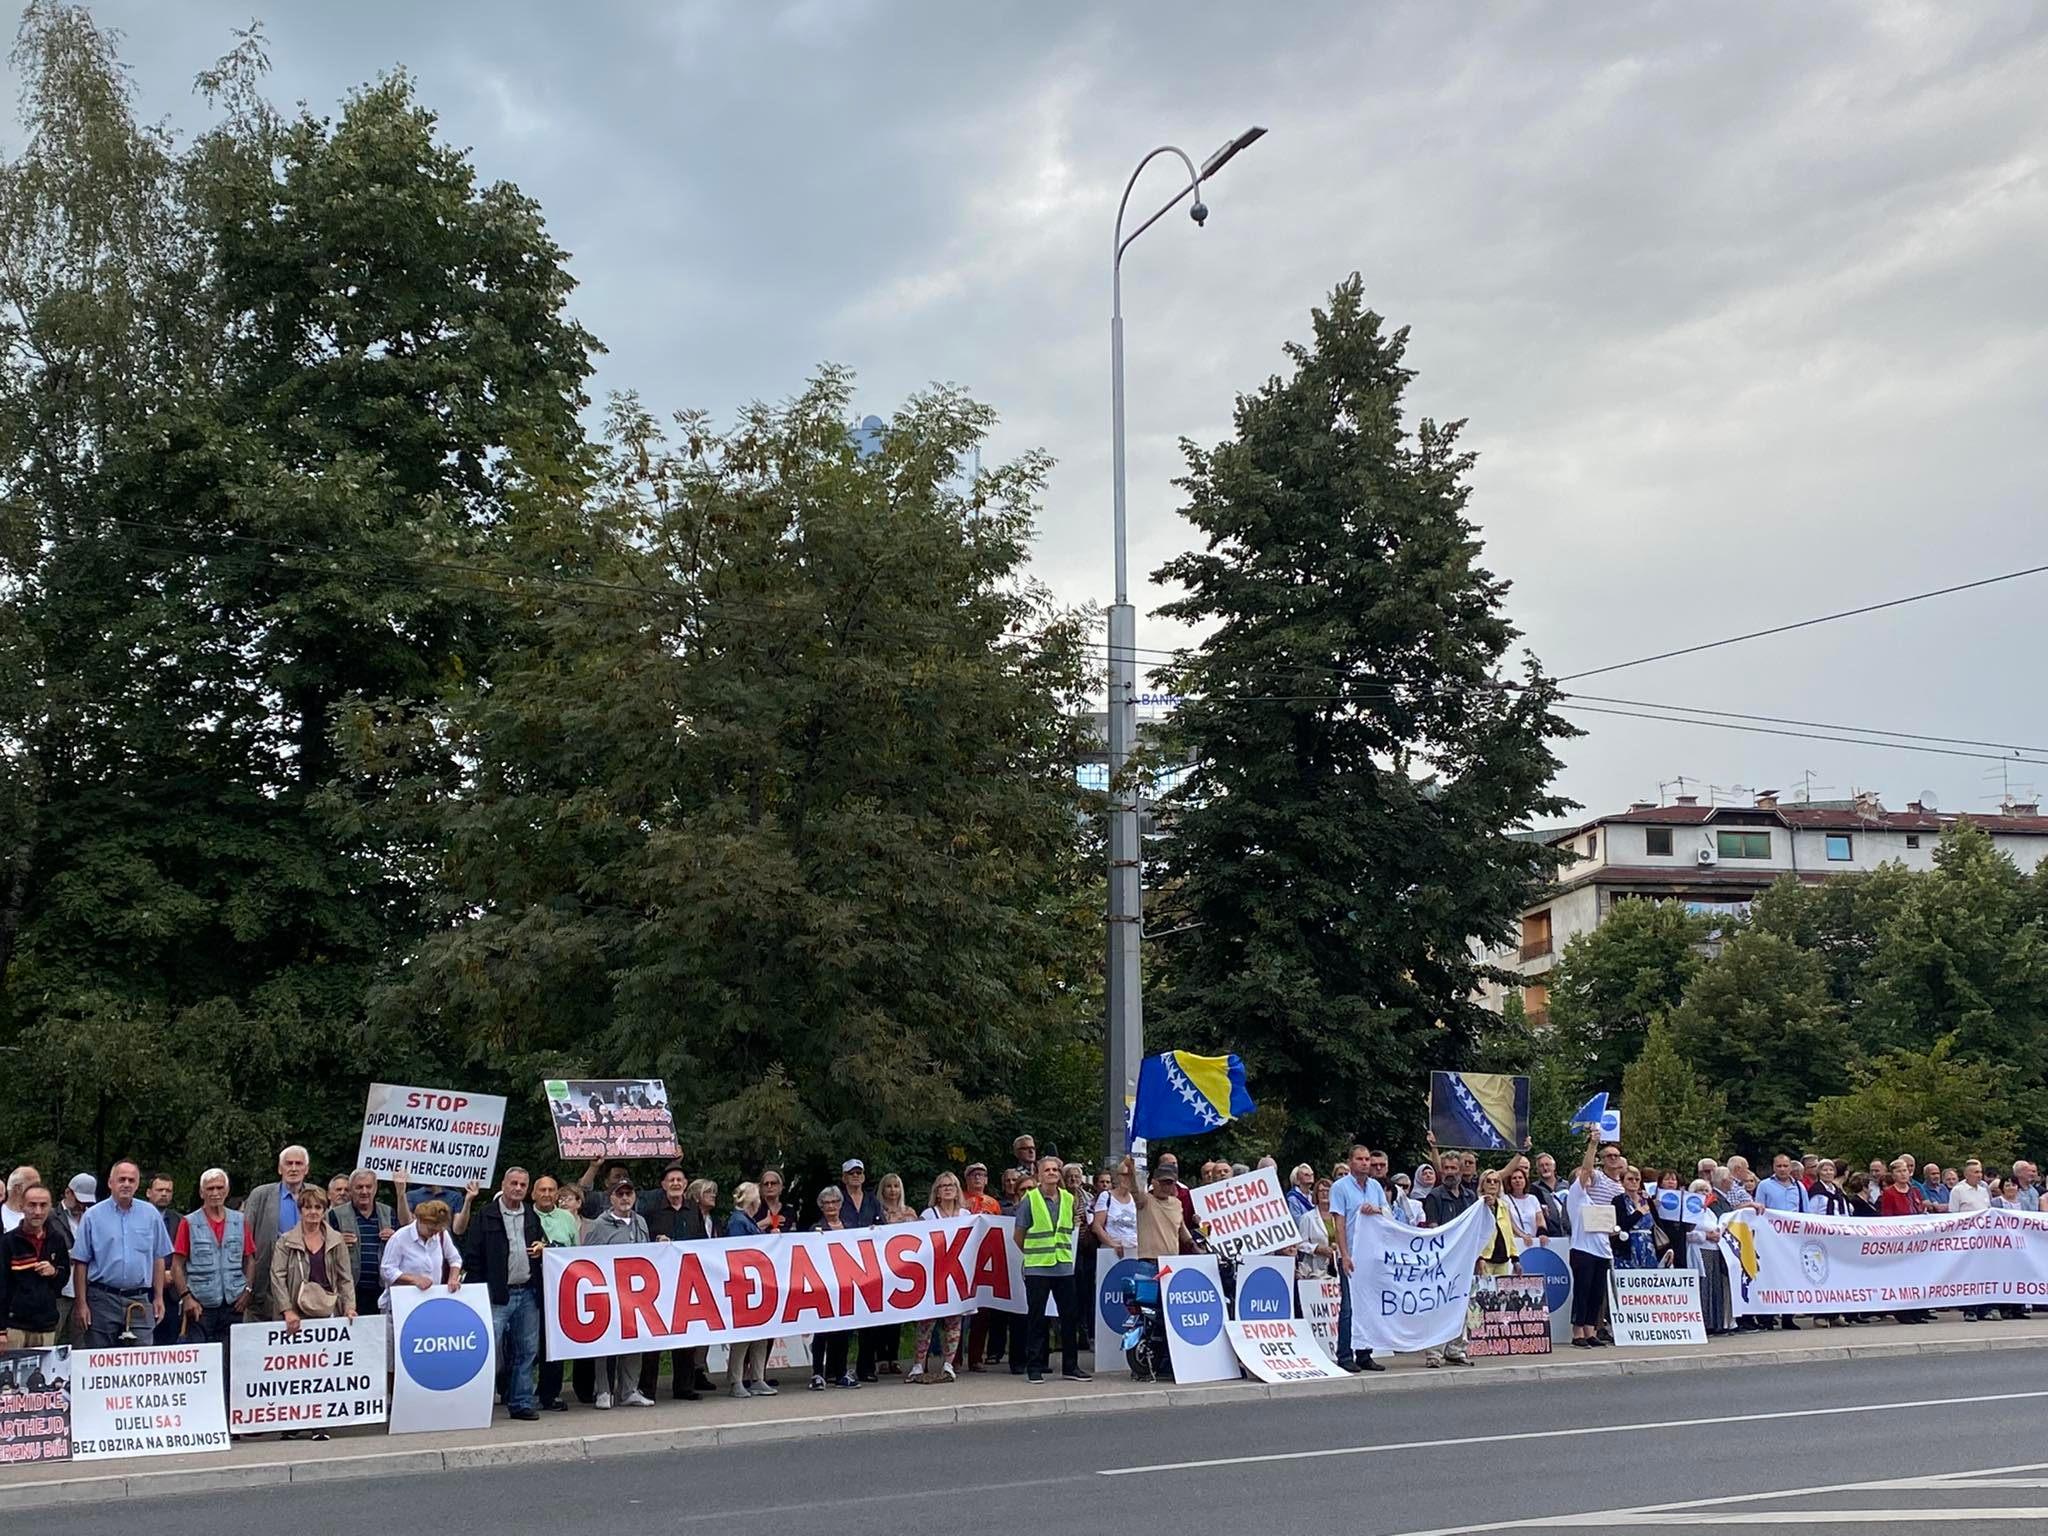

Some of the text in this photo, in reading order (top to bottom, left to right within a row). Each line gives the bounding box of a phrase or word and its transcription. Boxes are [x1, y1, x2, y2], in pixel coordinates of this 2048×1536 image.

[406, 1092, 468, 1112] STOP
[366, 1113, 501, 1137] DIPLOMATSKOJ AGRESIJI
[369, 1135, 490, 1158] HRVATSKE NA USTROJ
[364, 1156, 402, 1173] BOSNE
[410, 1160, 488, 1180] HERCEGOVINE
[1204, 1178, 1269, 1213] NEĆEMO
[1200, 1198, 1288, 1236] PRIHVATITI
[1804, 1221, 1851, 1236] MINUTE
[1852, 1224, 1868, 1236] TO
[1933, 1221, 1955, 1234] FOR
[1955, 1216, 1992, 1231] PEACE
[1994, 1216, 2020, 1230] AND
[1211, 1220, 1296, 1258] NEPRAVDU
[1410, 1235, 1444, 1253] ON
[1861, 1241, 1904, 1255] BOSNIA
[1906, 1239, 1928, 1254] AND
[1929, 1235, 2013, 1252] HERZEGOVINA
[1384, 1250, 1440, 1266] MENI
[1394, 1264, 1446, 1282] NEMA
[1547, 1276, 1568, 1285] FINCI
[1628, 1274, 1694, 1288] UGROŽAVAJTE
[558, 1226, 1012, 1344] GRAĐANSKA
[1757, 1290, 1794, 1304] "MINUT
[1797, 1290, 1813, 1304] DO
[1815, 1288, 1878, 1304] DVANAEST"
[1881, 1288, 1898, 1301] ZA
[1899, 1286, 1921, 1300] MIR
[1923, 1286, 1926, 1299] I
[1929, 1281, 1999, 1298] PROSPERITET
[2002, 1282, 2012, 1295] U
[1169, 1290, 1216, 1305] PRESUDE
[1250, 1299, 1279, 1313] PILAV
[1621, 1294, 1688, 1306] DEMOKRATIJU
[1310, 1303, 1329, 1318] VAM
[1612, 1312, 1701, 1323] TO NISU EVROPSKE
[1181, 1313, 1209, 1327] ESLJP
[268, 1327, 350, 1346] PRESUDA
[1242, 1322, 1297, 1339] EVROPA
[1628, 1329, 1692, 1341] VRIJEDNOSTI
[413, 1331, 477, 1354] ZORNIĆ
[1259, 1342, 1296, 1356] OPET
[89, 1350, 199, 1368] KONSTITUTIVNOST
[264, 1348, 353, 1371] ZORNIĆ JE
[1263, 1357, 1317, 1371] IZDAJE
[82, 1371, 207, 1390] I JEDNAKOPRAVNOST
[1278, 1369, 1329, 1380] BOSNU
[246, 1375, 370, 1398] UNIVERZALNO
[106, 1393, 187, 1410] NIJE KADA SE
[232, 1399, 383, 1425] RJEŠENJE ZA BIH
[115, 1415, 181, 1431] DIJELI SA 3
[73, 1432, 226, 1454] BEZ OBZIRA NA BROJNOST
